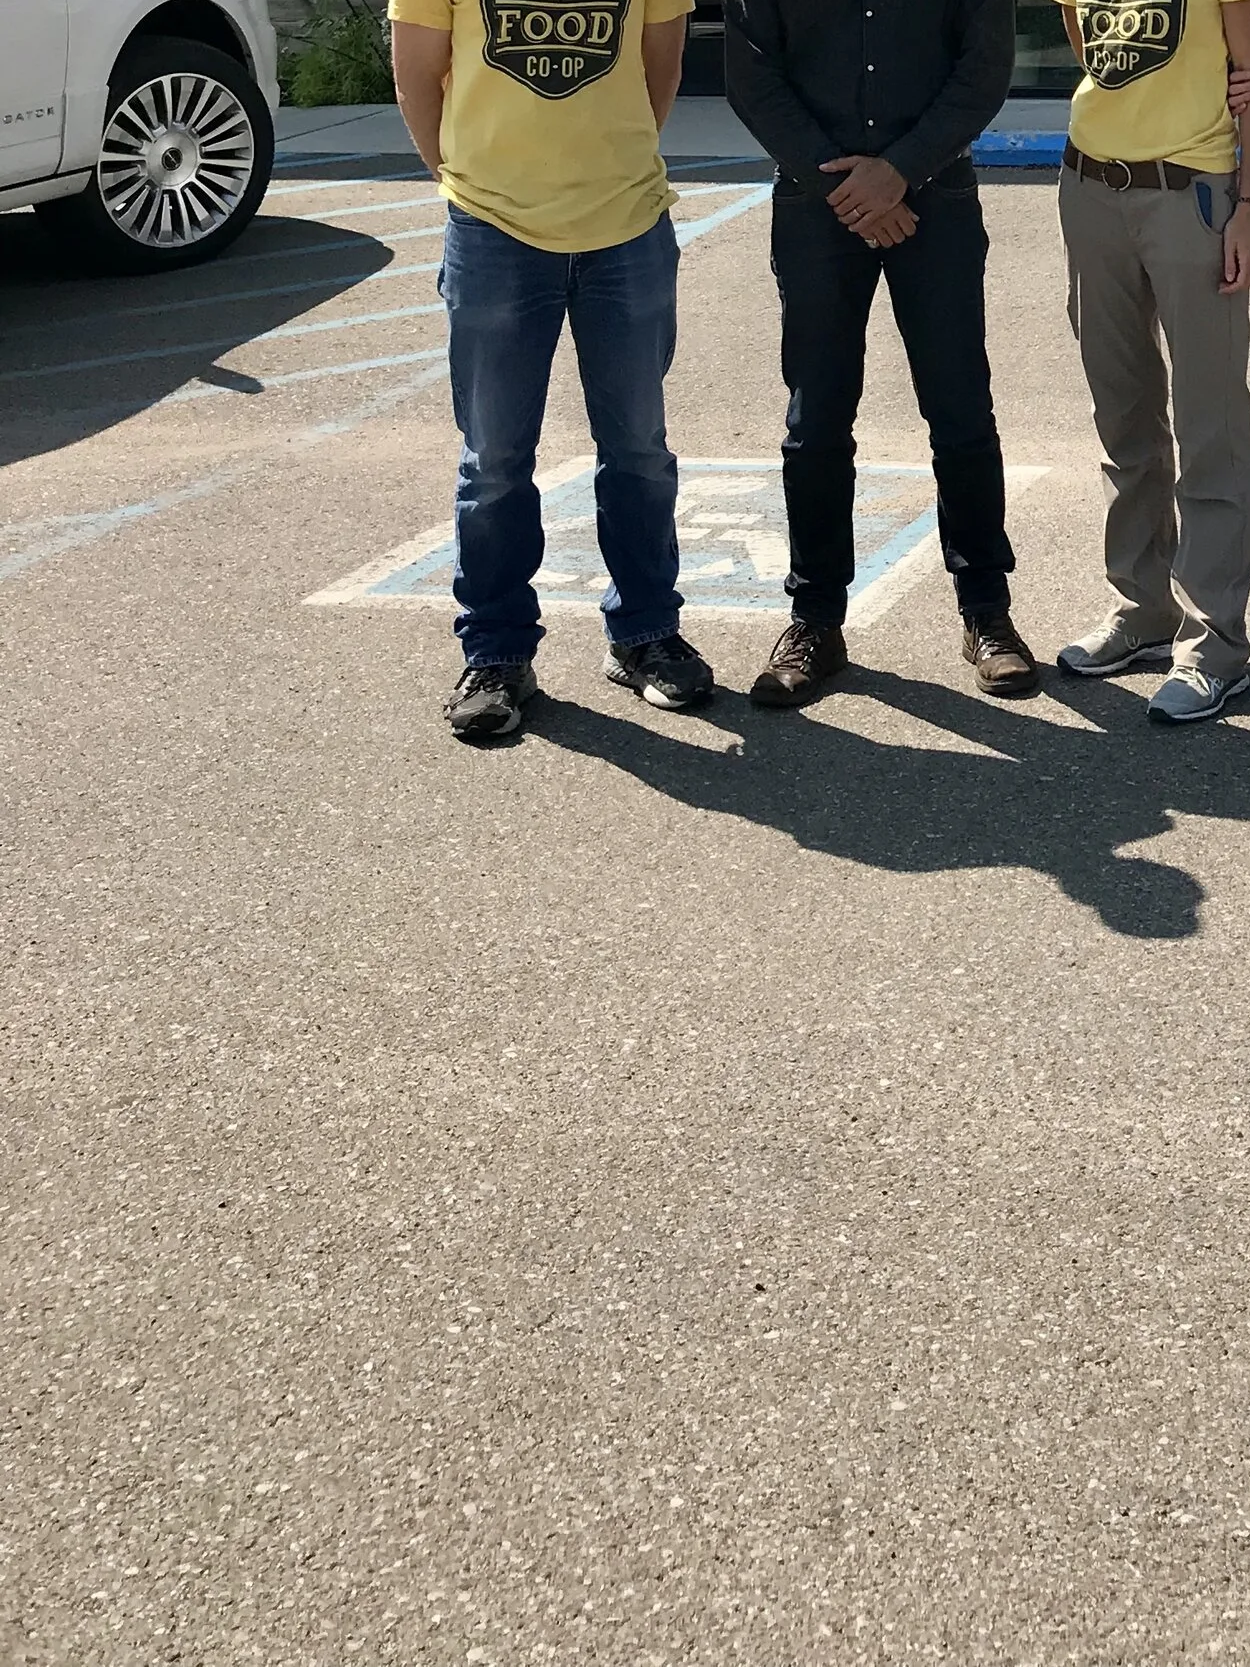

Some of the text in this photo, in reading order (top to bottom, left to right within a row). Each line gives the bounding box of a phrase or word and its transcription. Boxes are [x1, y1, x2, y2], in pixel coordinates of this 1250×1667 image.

[496, 9, 614, 45] FOOD
[1076, 7, 1170, 40] FOOD
[526, 55, 585, 78] CO-OP
